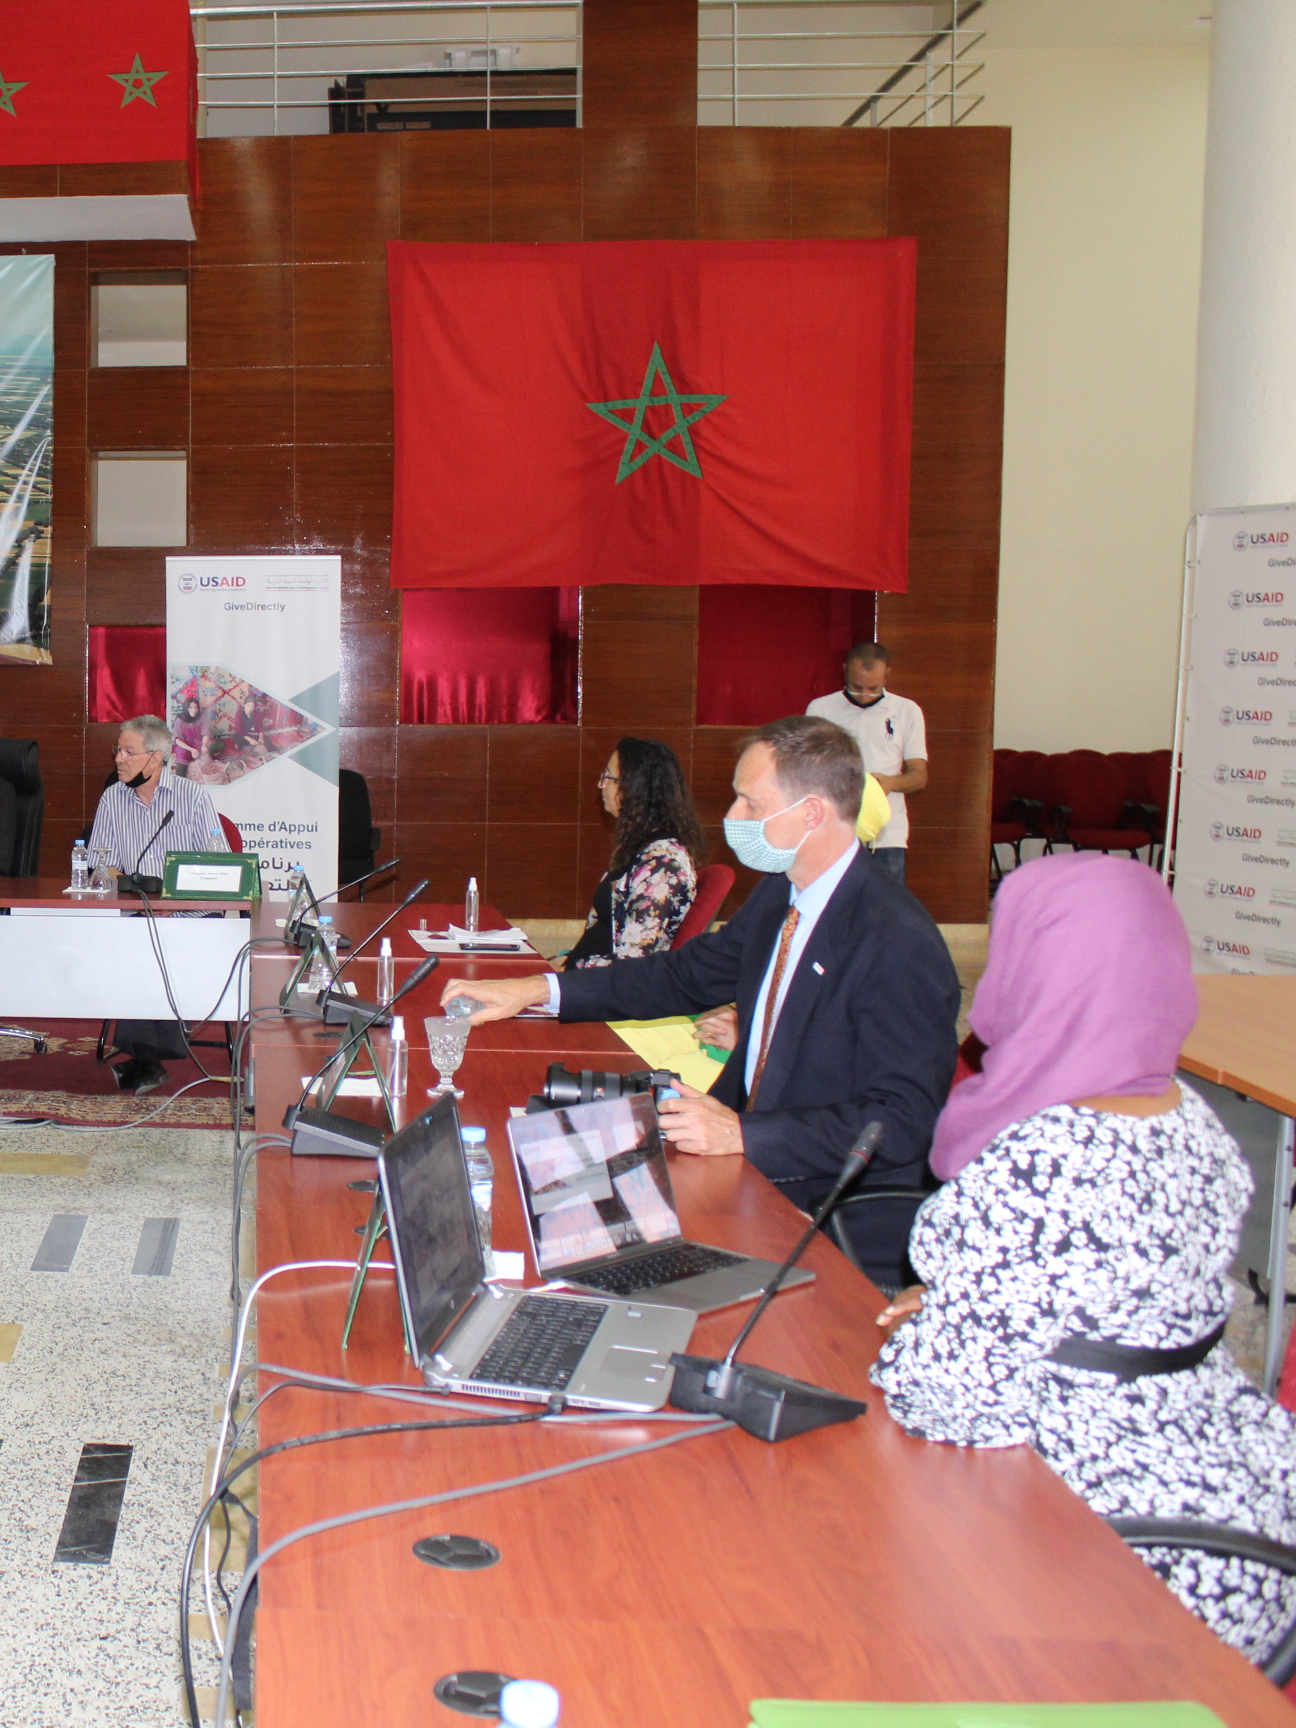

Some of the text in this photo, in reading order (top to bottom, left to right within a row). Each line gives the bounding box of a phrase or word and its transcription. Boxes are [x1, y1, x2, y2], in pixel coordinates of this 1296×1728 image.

[1250, 532, 1289, 544] USAID
[199, 577, 246, 587] USAID
[1245, 592, 1284, 603] USAID
[224, 602, 286, 612] GiveDirectly
[1241, 651, 1279, 662] USAID
[1236, 710, 1273, 721] USAID
[1230, 768, 1267, 780] USAID
[1247, 794, 1296, 808] GiveDirectly
[268, 821, 318, 835] d'Appui
[1226, 826, 1262, 839] USAID
[1242, 852, 1290, 867] GiveDirectly
[1220, 883, 1256, 898] USAID
[1235, 911, 1281, 928] GiveDirectly
[1216, 941, 1250, 955] USAID
